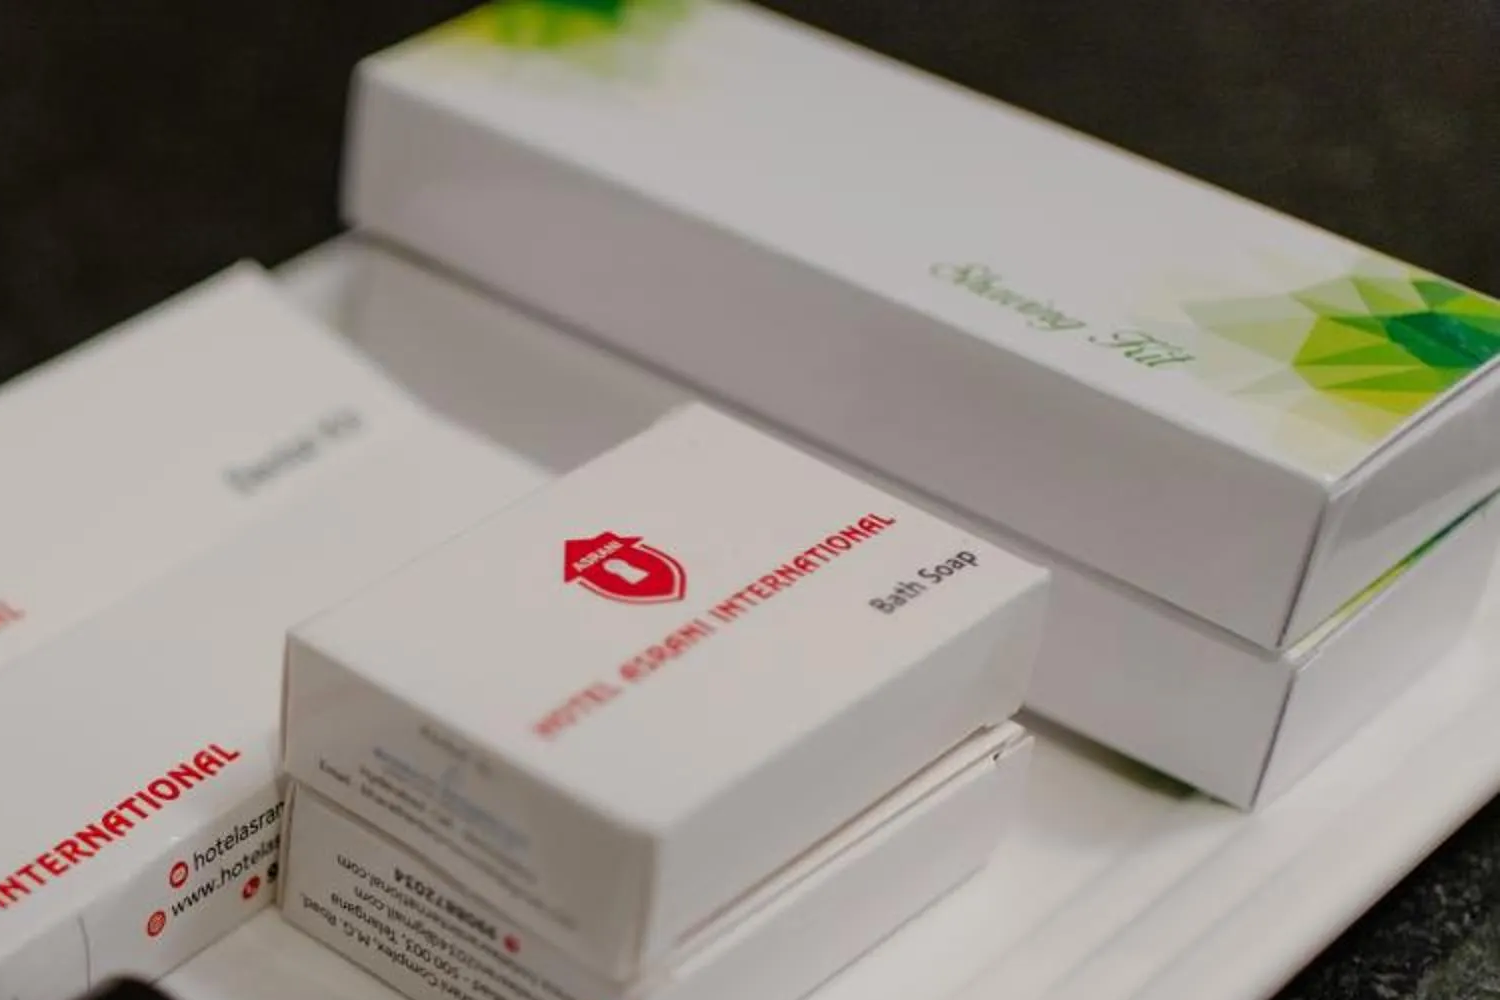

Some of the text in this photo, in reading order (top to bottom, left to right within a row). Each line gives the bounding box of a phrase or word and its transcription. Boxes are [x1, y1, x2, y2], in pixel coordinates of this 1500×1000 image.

[928, 262, 1196, 367] Shaving Kit
[572, 540, 623, 572] ASRANI
[868, 548, 981, 615] Bath Soap
[530, 512, 896, 740] HOTEL ASRANI INTERNATIONAL
